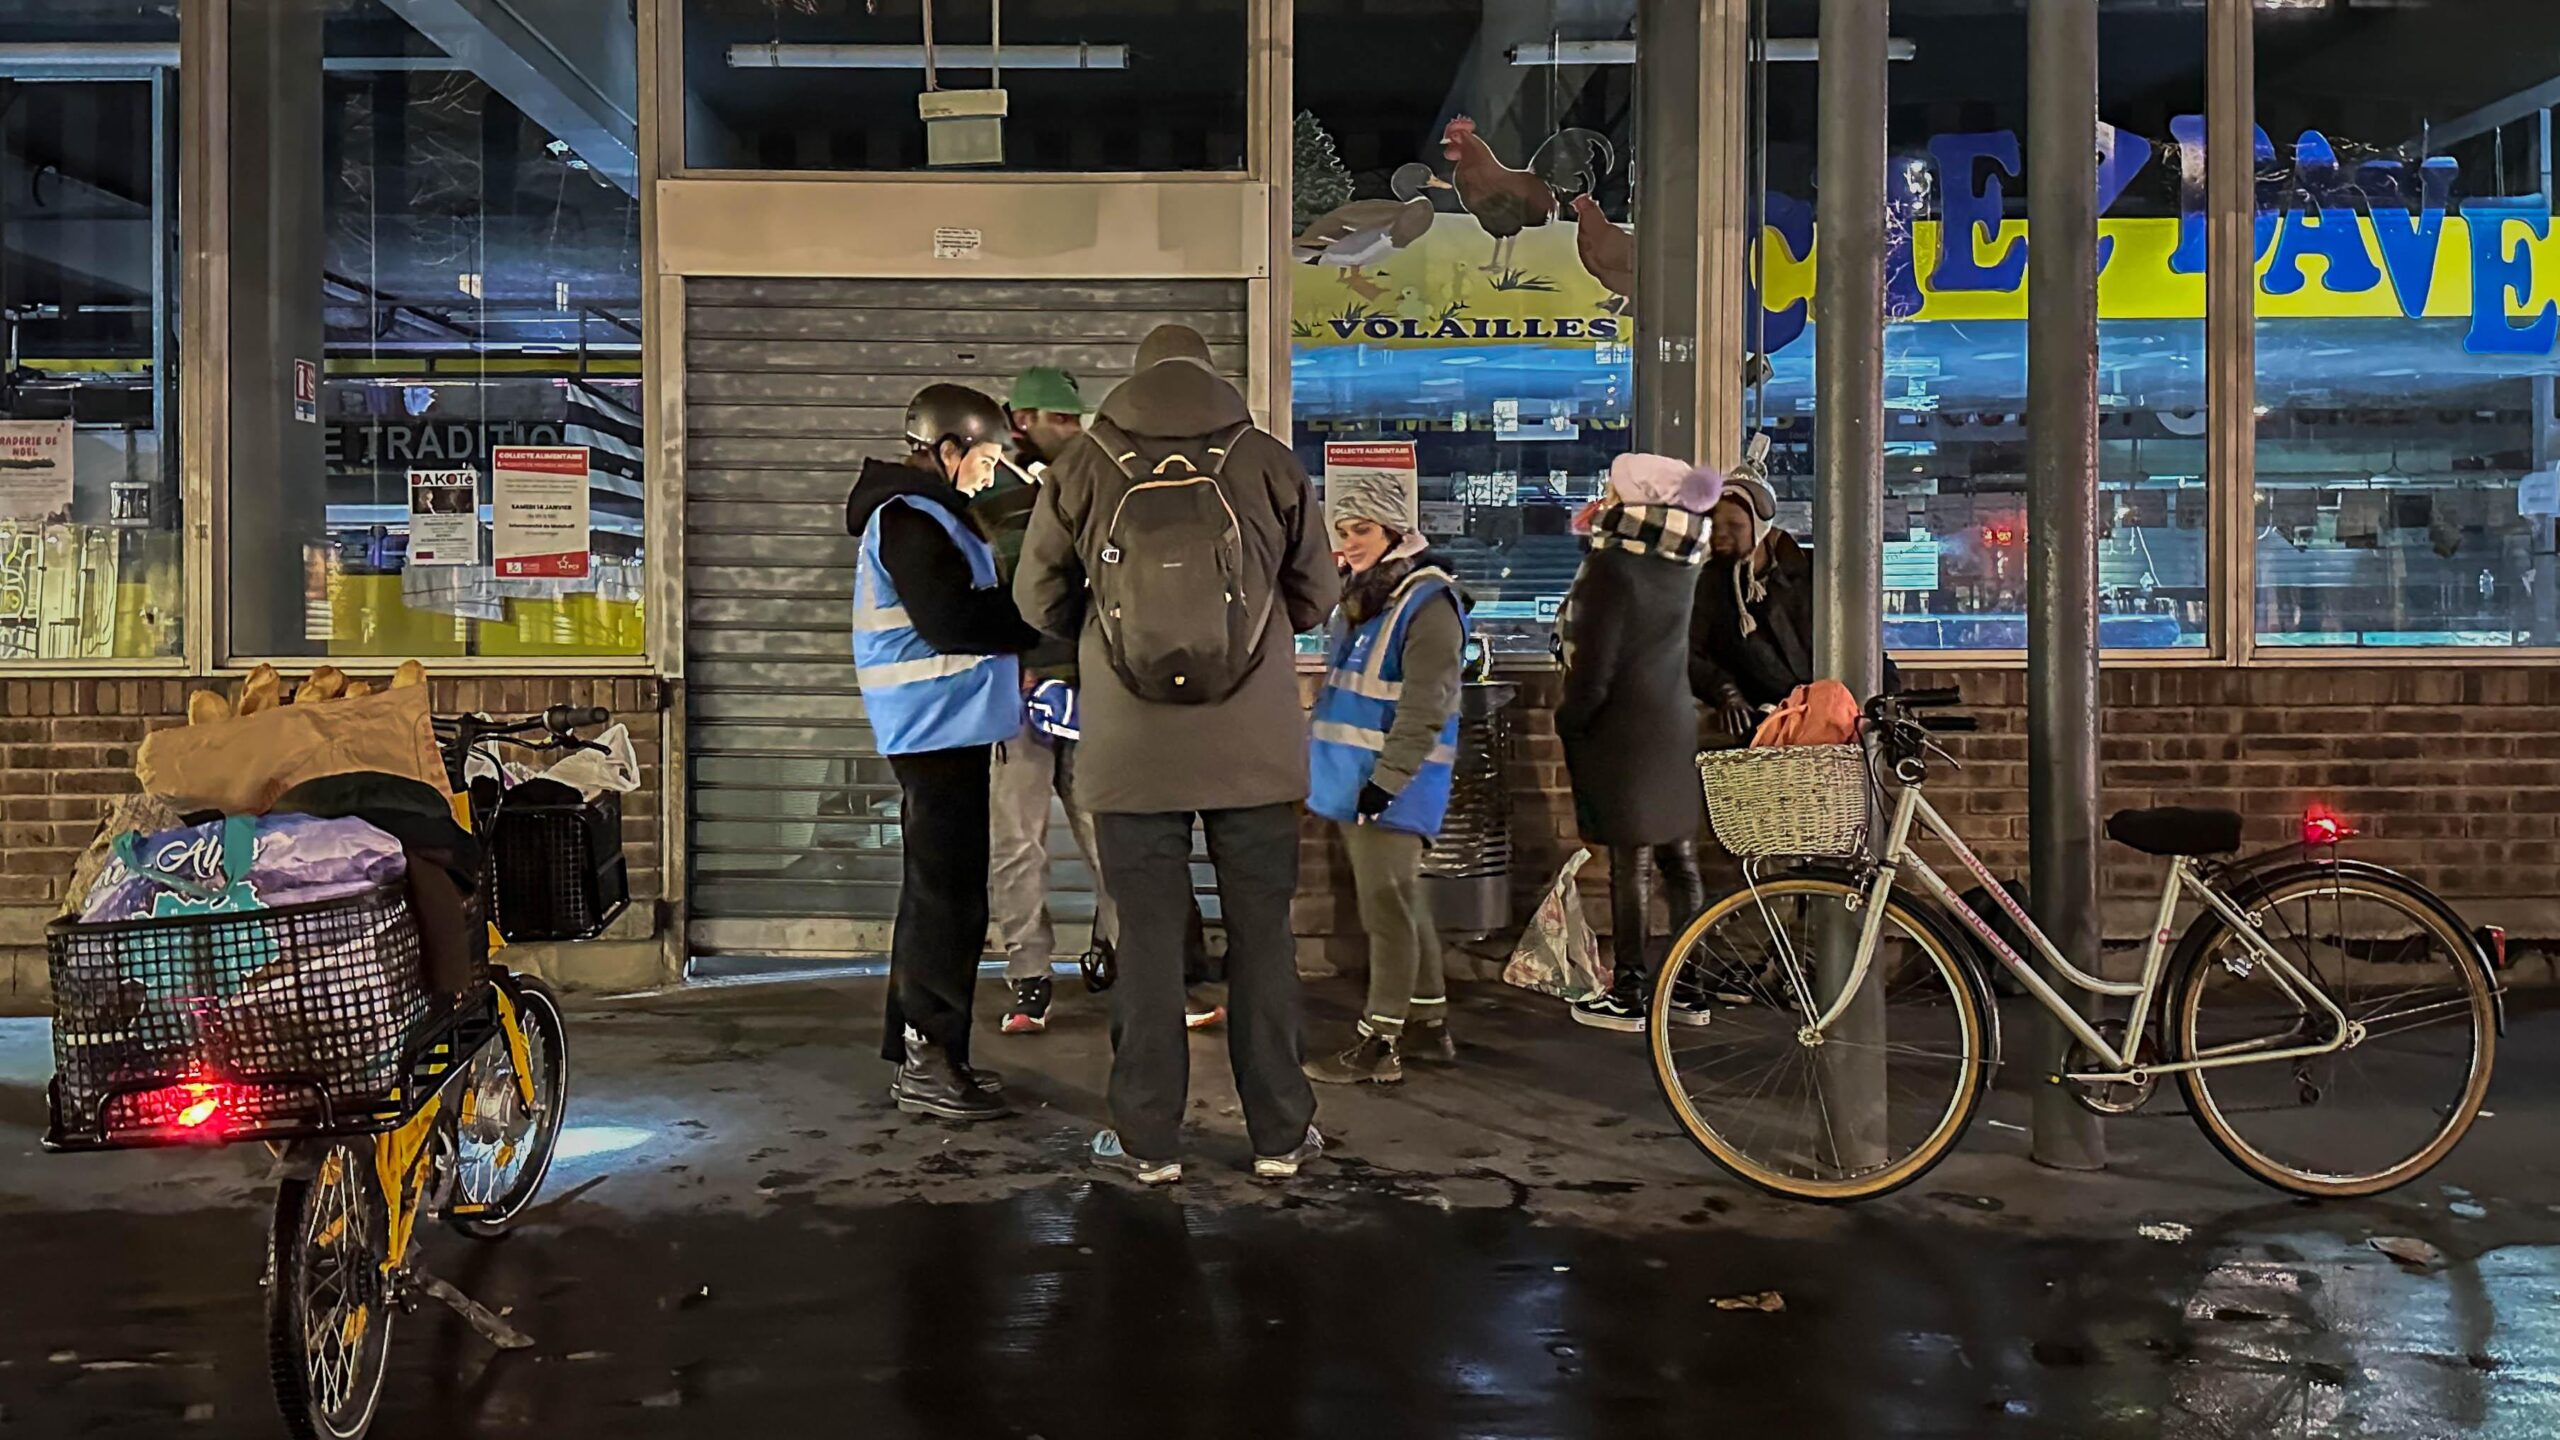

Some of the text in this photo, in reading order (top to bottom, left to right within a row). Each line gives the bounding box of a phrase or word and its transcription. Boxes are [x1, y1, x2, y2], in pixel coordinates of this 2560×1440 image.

[1327, 318, 1618, 339] VOLAILLES
[498, 452, 534, 460] COLLECTE
[1943, 887, 2020, 966] PEUGEOT
